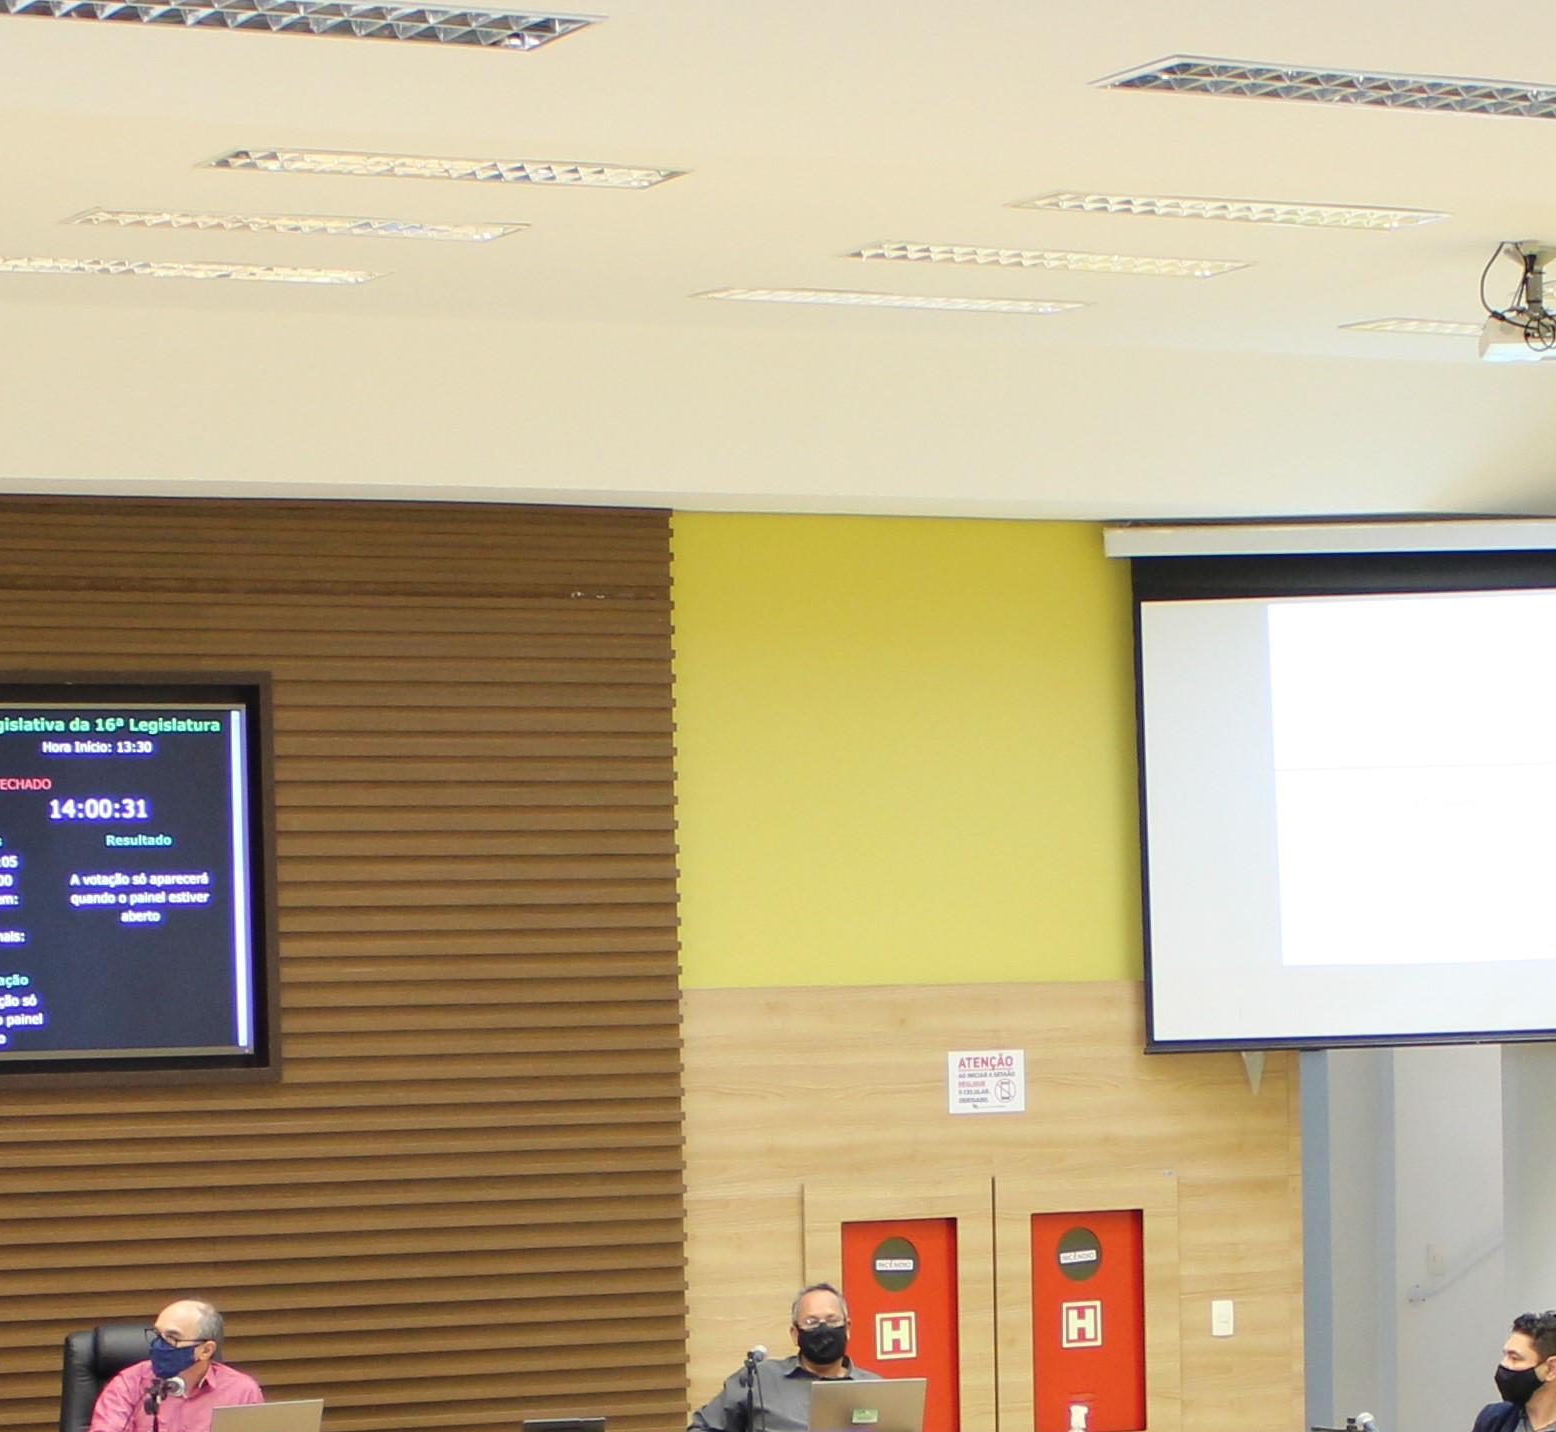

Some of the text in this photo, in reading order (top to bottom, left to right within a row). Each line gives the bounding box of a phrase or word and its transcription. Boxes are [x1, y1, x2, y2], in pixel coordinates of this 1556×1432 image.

[69, 717, 90, 731] da
[95, 717, 125, 731] 16ª
[129, 718, 221, 734] Legislatura
[42, 741, 71, 753] Hora
[117, 741, 153, 753] 13:30
[49, 799, 148, 819] 14:00:31
[106, 834, 173, 846] Resultado
[70, 872, 209, 887] A votação só aparecerá
[70, 891, 210, 906] quando o painel estiver
[120, 910, 161, 922] aberto
[22, 994, 38, 1007] só
[6, 1013, 43, 1028] painel
[958, 1053, 1014, 1070] ATENÇÃO
[1068, 1308, 1095, 1340] H
[882, 1319, 910, 1351] H
